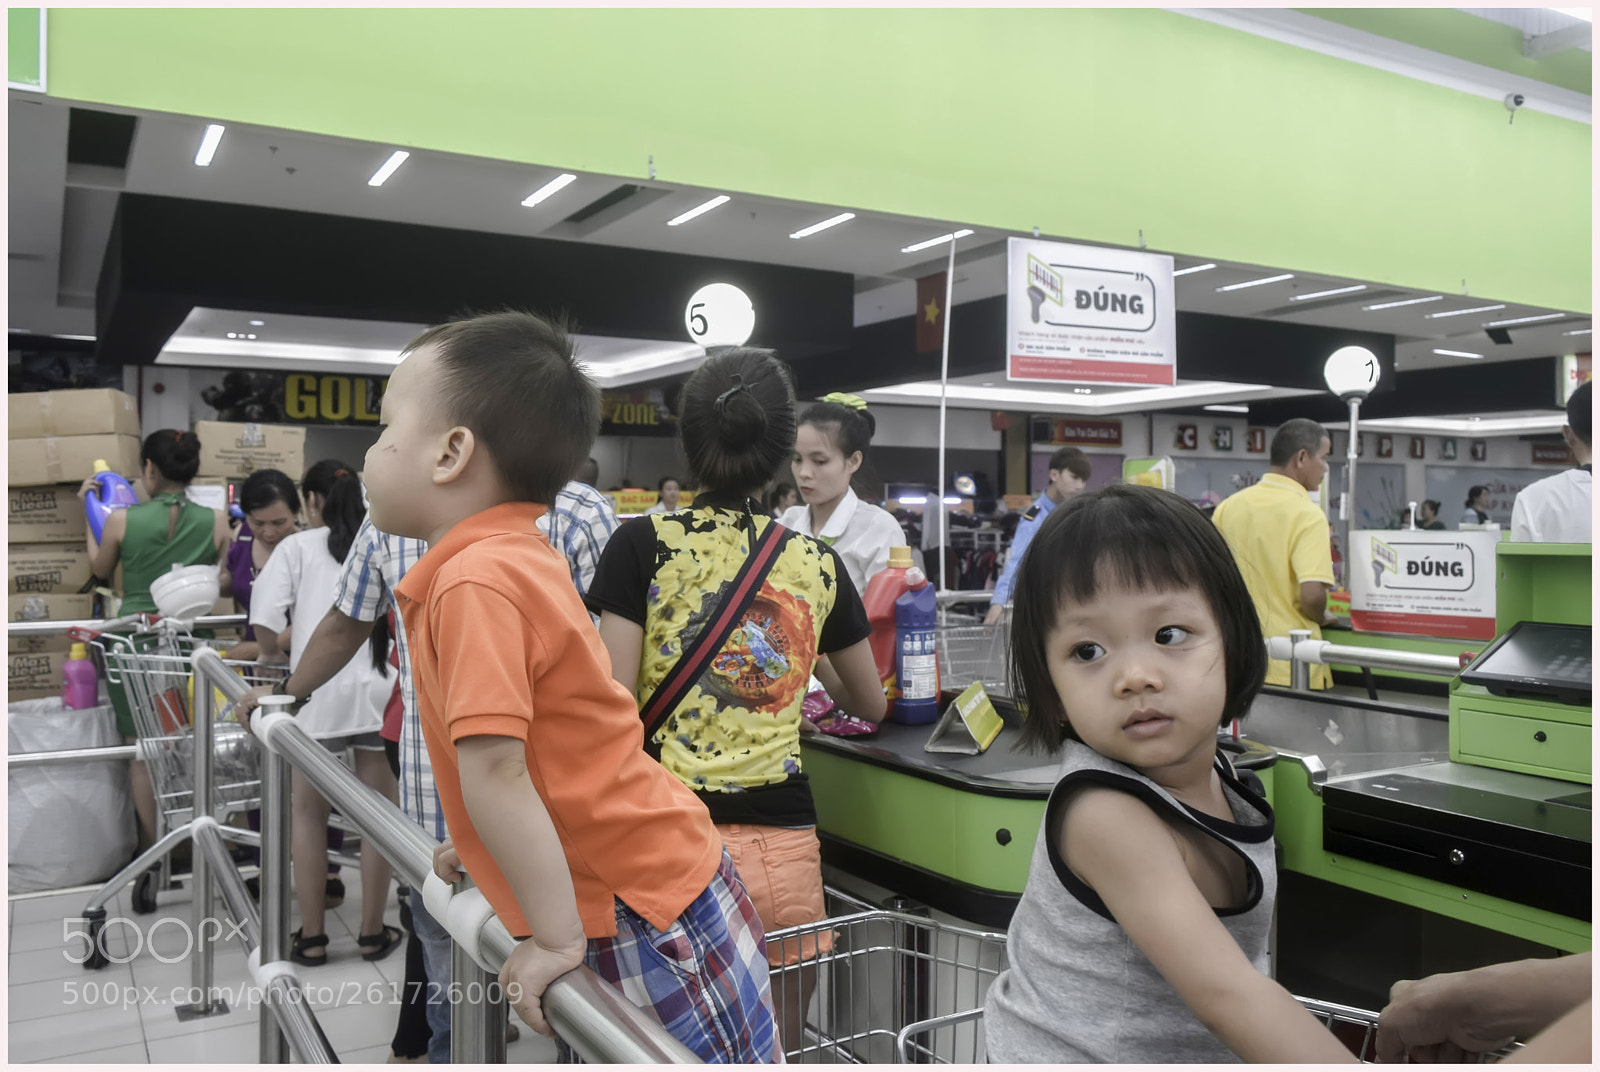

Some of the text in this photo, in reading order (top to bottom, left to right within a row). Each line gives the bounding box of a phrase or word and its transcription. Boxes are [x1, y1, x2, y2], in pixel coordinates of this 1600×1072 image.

[1075, 285, 1144, 315] ĐÚNG
[690, 302, 709, 336] 5
[285, 374, 387, 421] GOL
[1406, 557, 1464, 578] ĐÚNG
